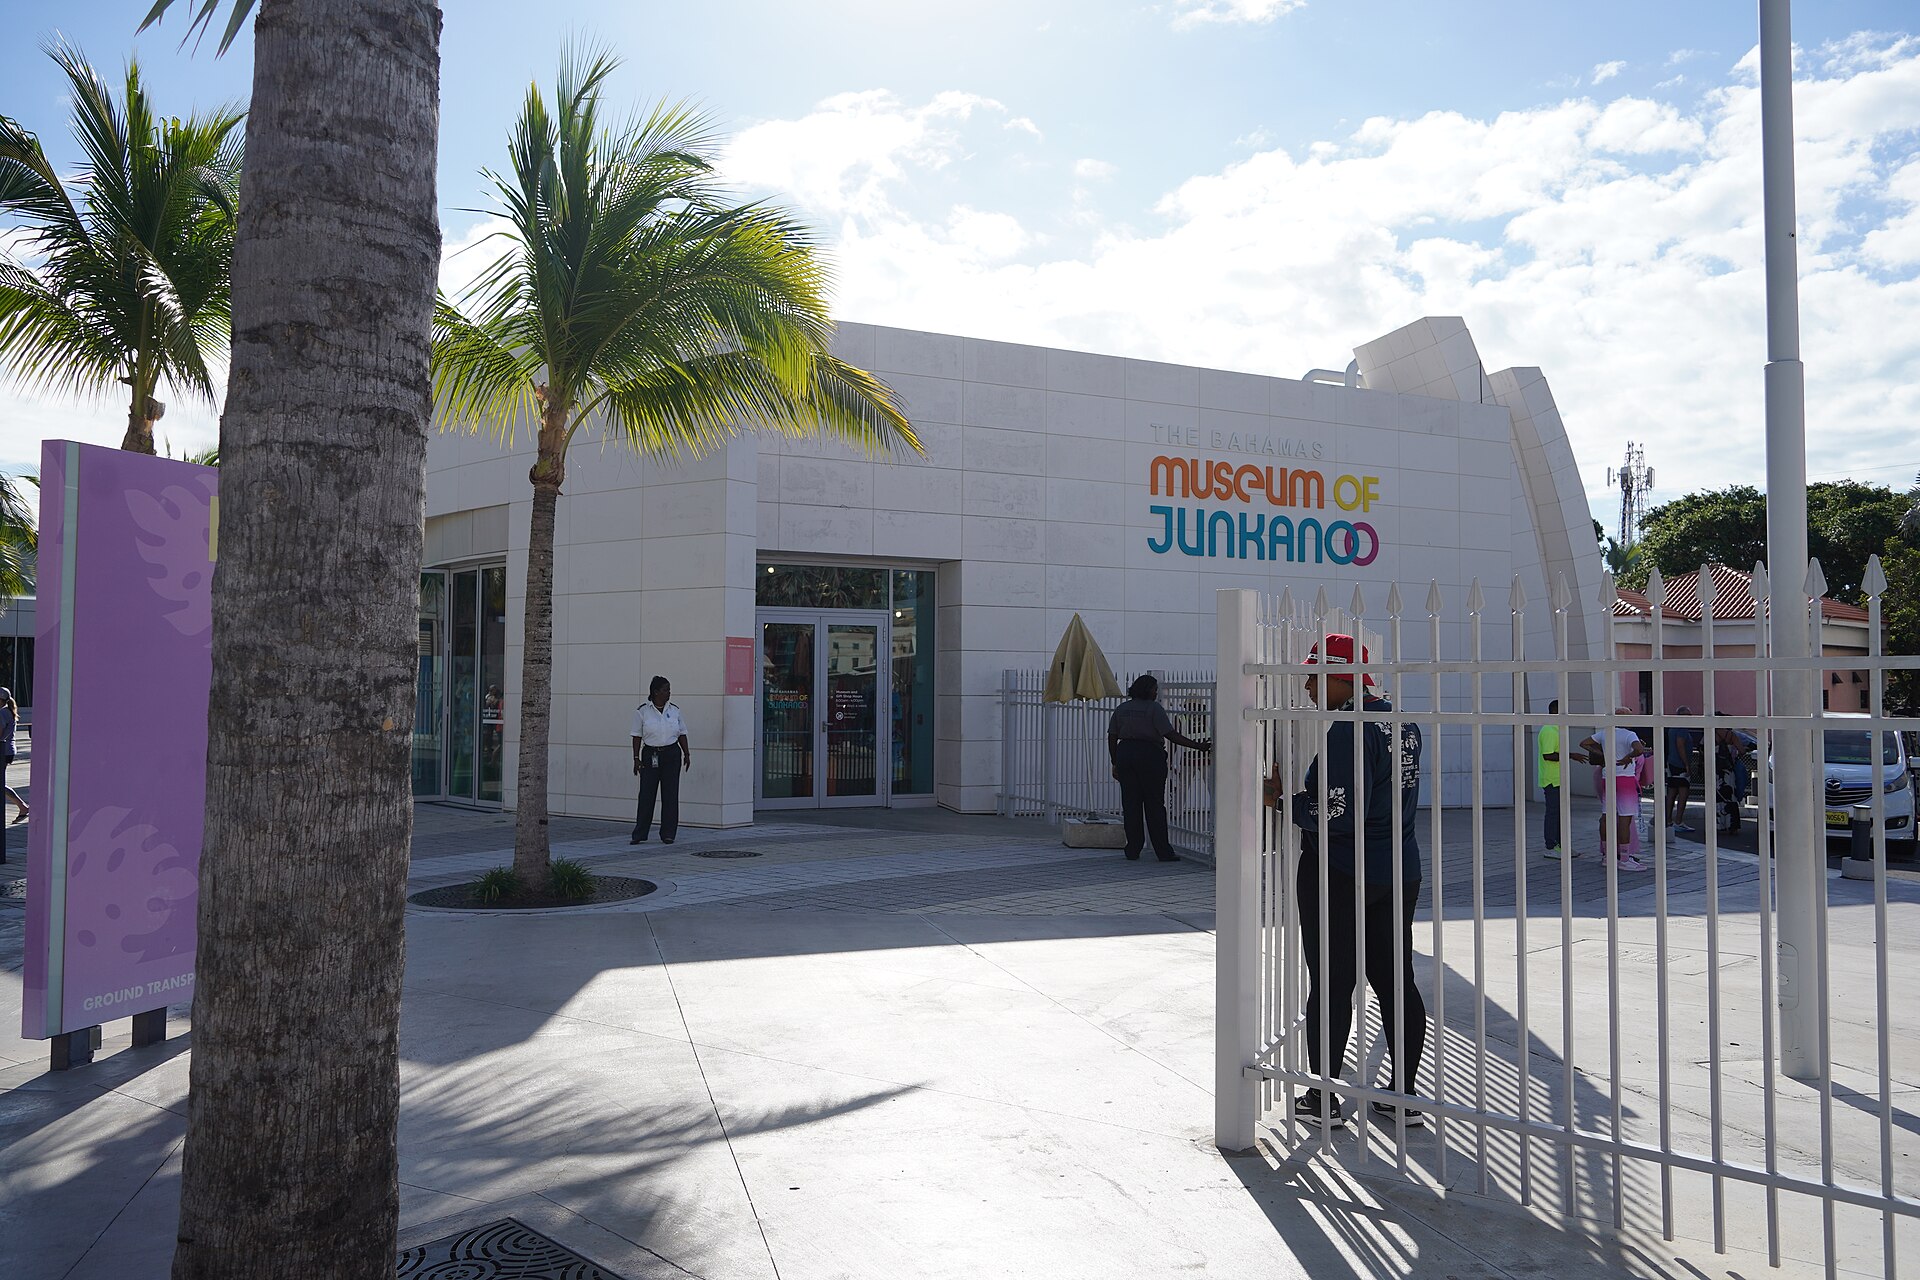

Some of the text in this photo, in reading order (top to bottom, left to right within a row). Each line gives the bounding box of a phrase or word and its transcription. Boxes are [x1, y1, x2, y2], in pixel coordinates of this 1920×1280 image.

[1150, 424, 1324, 460] THE BAHAMAS
[1333, 474, 1379, 513] OF
[1147, 505, 1379, 567] JUNKANOO
[84, 985, 143, 1011] GROUND
